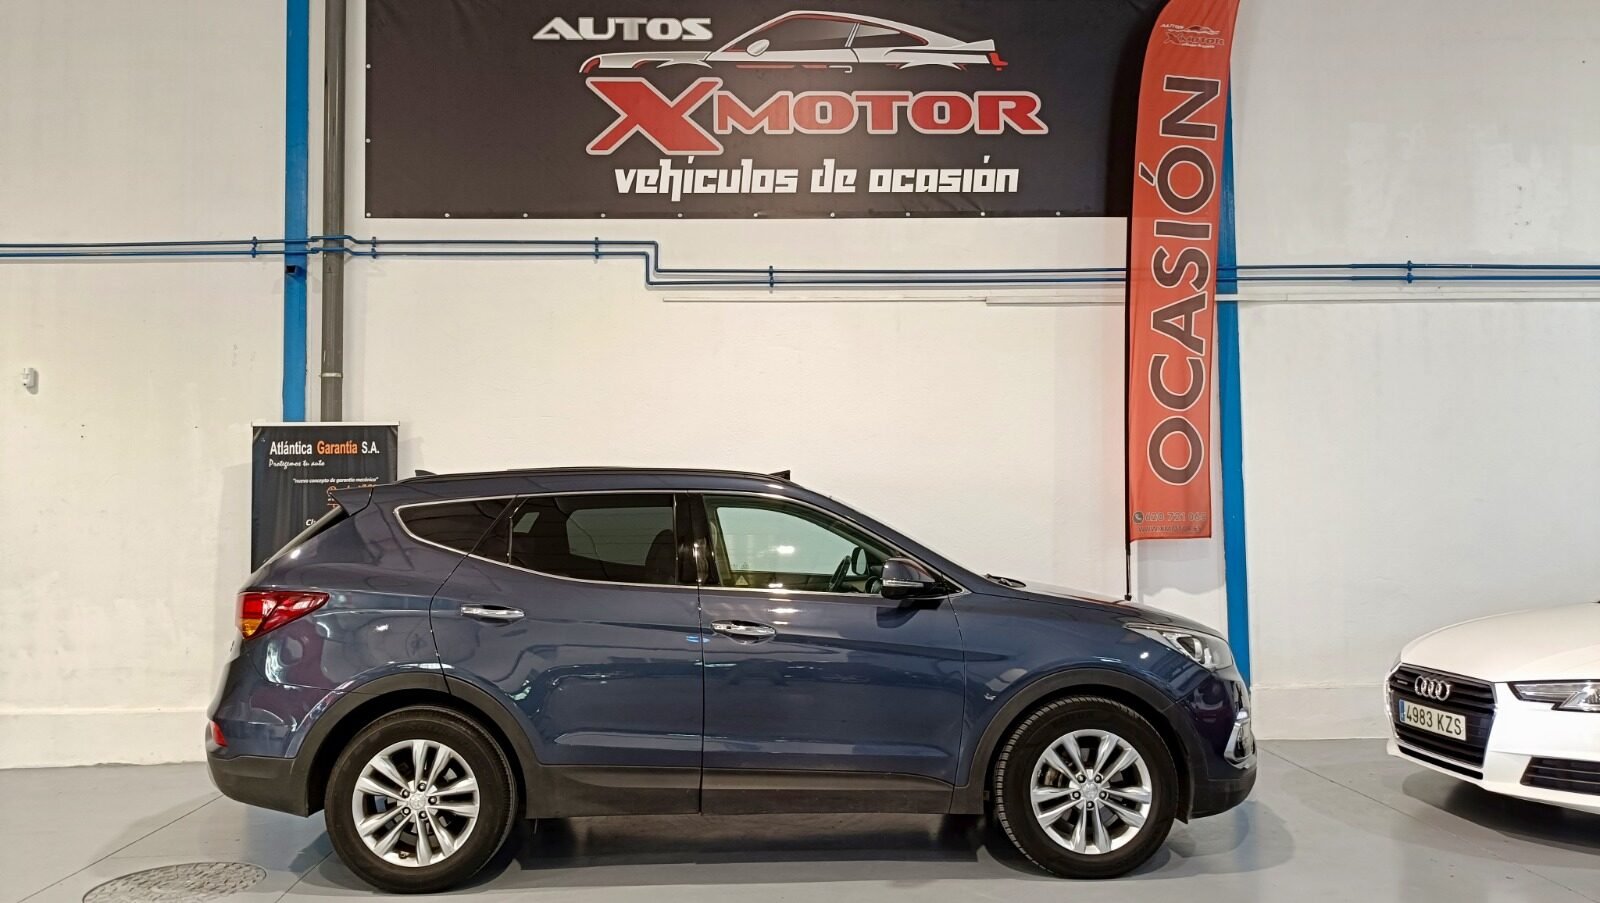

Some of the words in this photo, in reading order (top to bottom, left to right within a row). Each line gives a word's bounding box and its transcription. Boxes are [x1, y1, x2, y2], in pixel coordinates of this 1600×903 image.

[532, 17, 713, 41] AUTOS
[586, 76, 1049, 156] XMOTOR
[615, 156, 799, 202] vehículos
[811, 158, 857, 194] de
[869, 155, 1020, 194] ocasión
[1139, 75, 1221, 486] OCASIÓN
[269, 440, 313, 456] Atlántica
[316, 440, 358, 455] Garantía
[361, 441, 380, 454] S.A.
[1406, 704, 1433, 728] 4983
[1437, 712, 1462, 736] KZS
